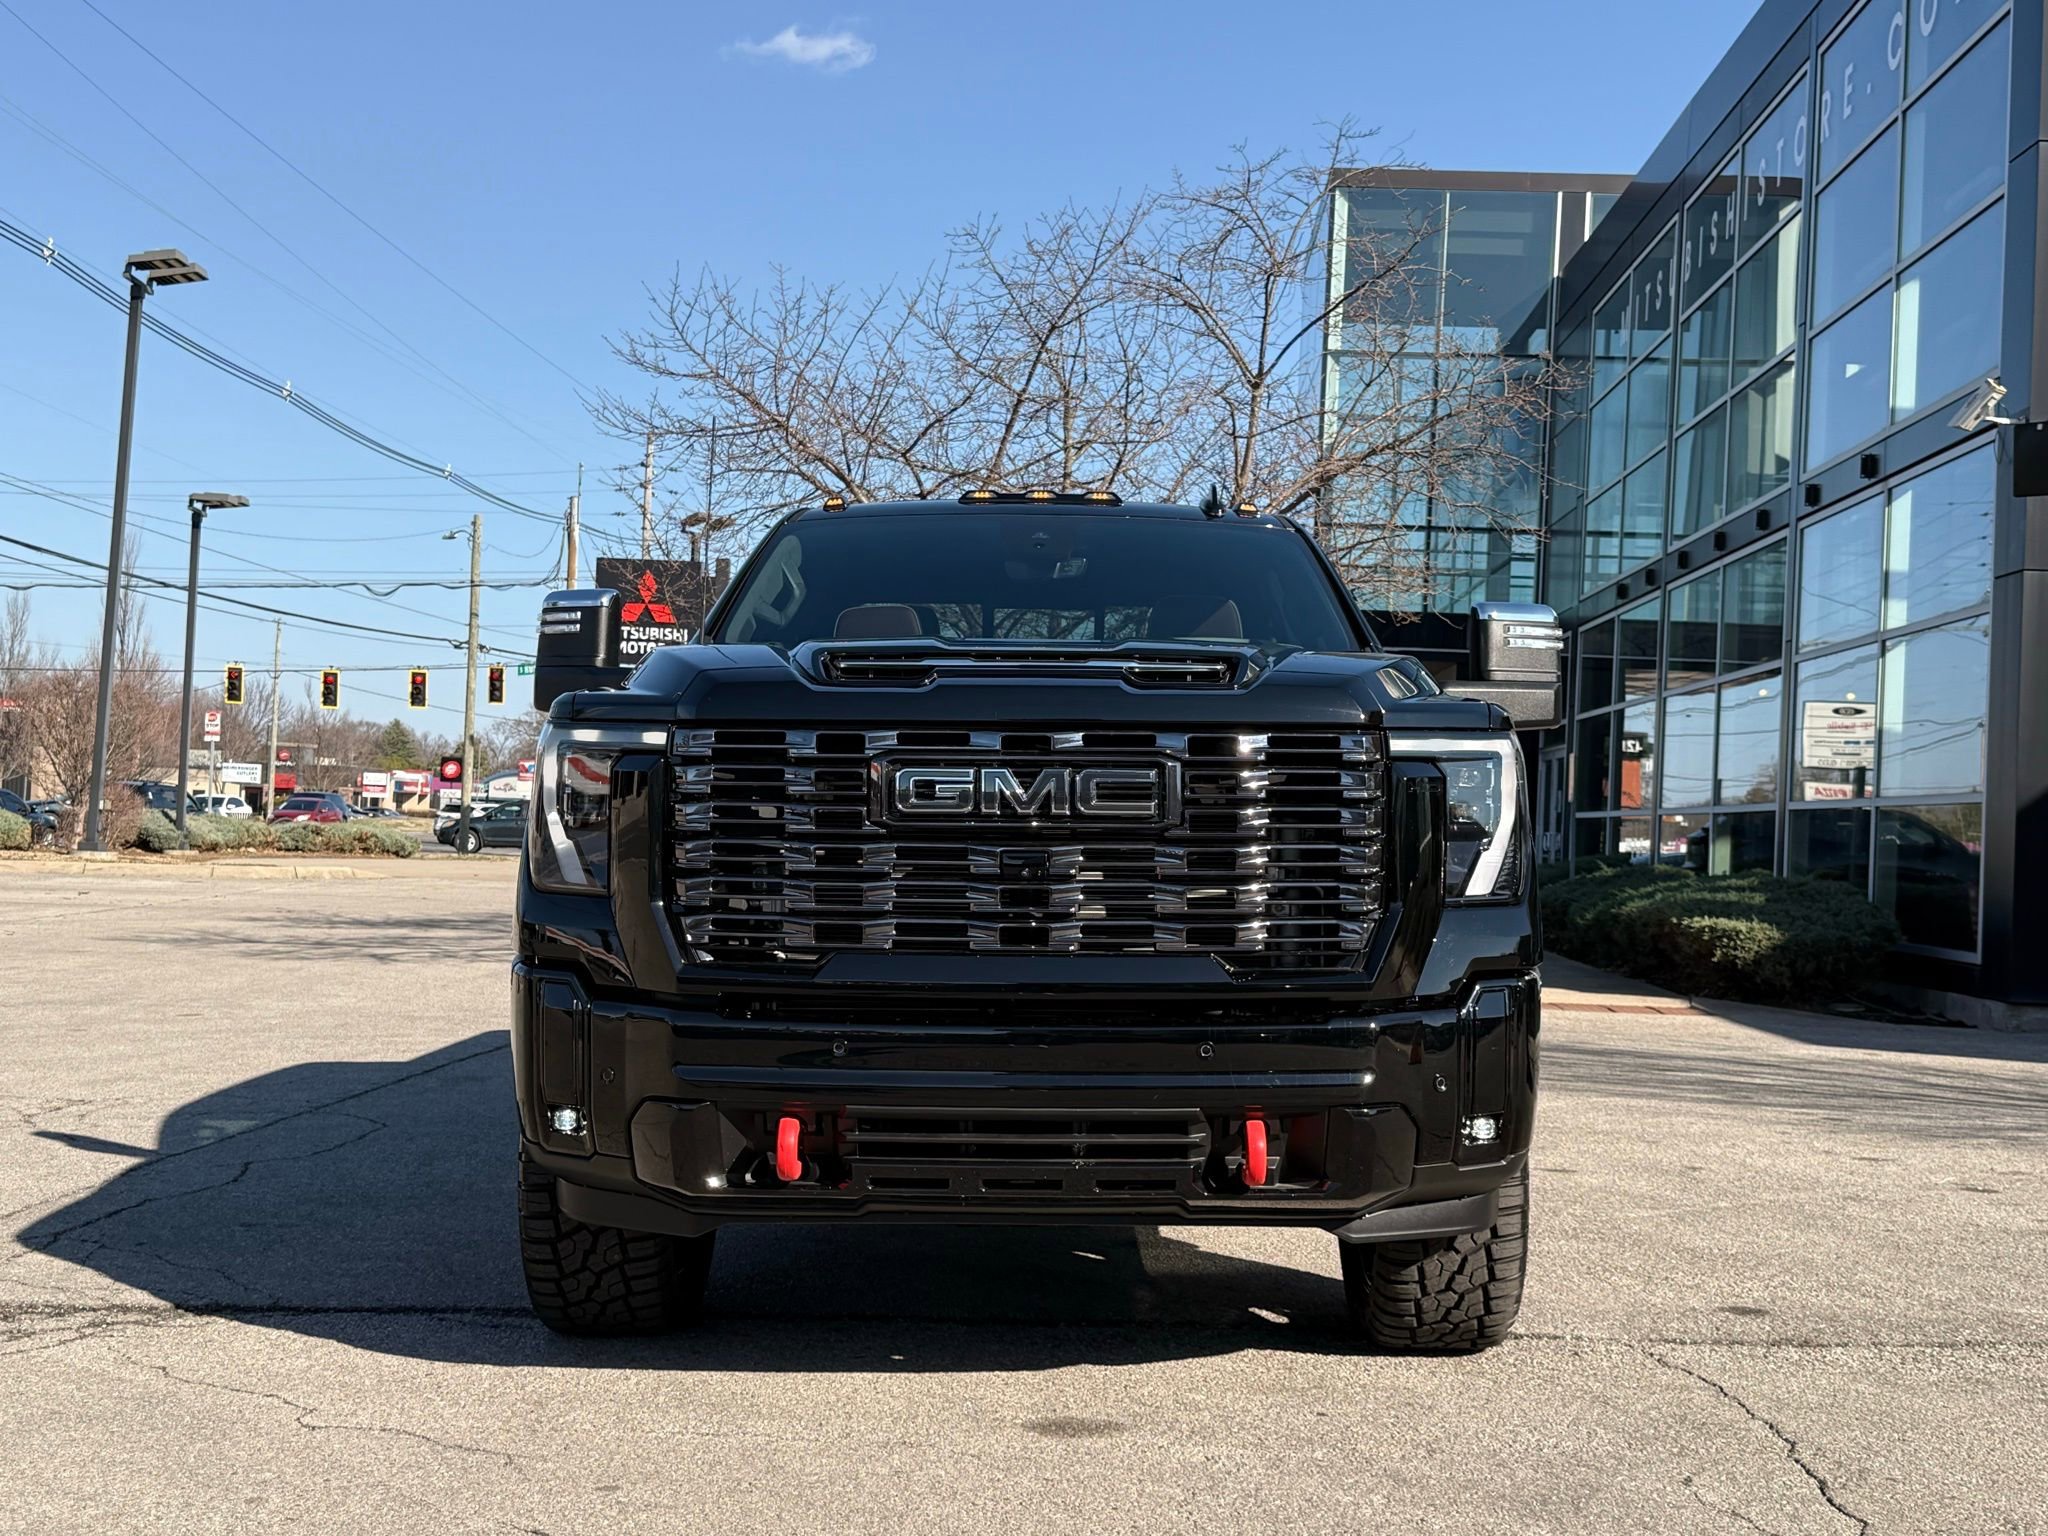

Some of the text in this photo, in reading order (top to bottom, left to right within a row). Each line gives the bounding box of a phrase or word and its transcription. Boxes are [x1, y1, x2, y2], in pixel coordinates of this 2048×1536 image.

[1619, 0, 1961, 348] MITSUBISHISTORE.CO
[620, 626, 688, 641] TSUBISHI
[895, 767, 1158, 815] GMC
